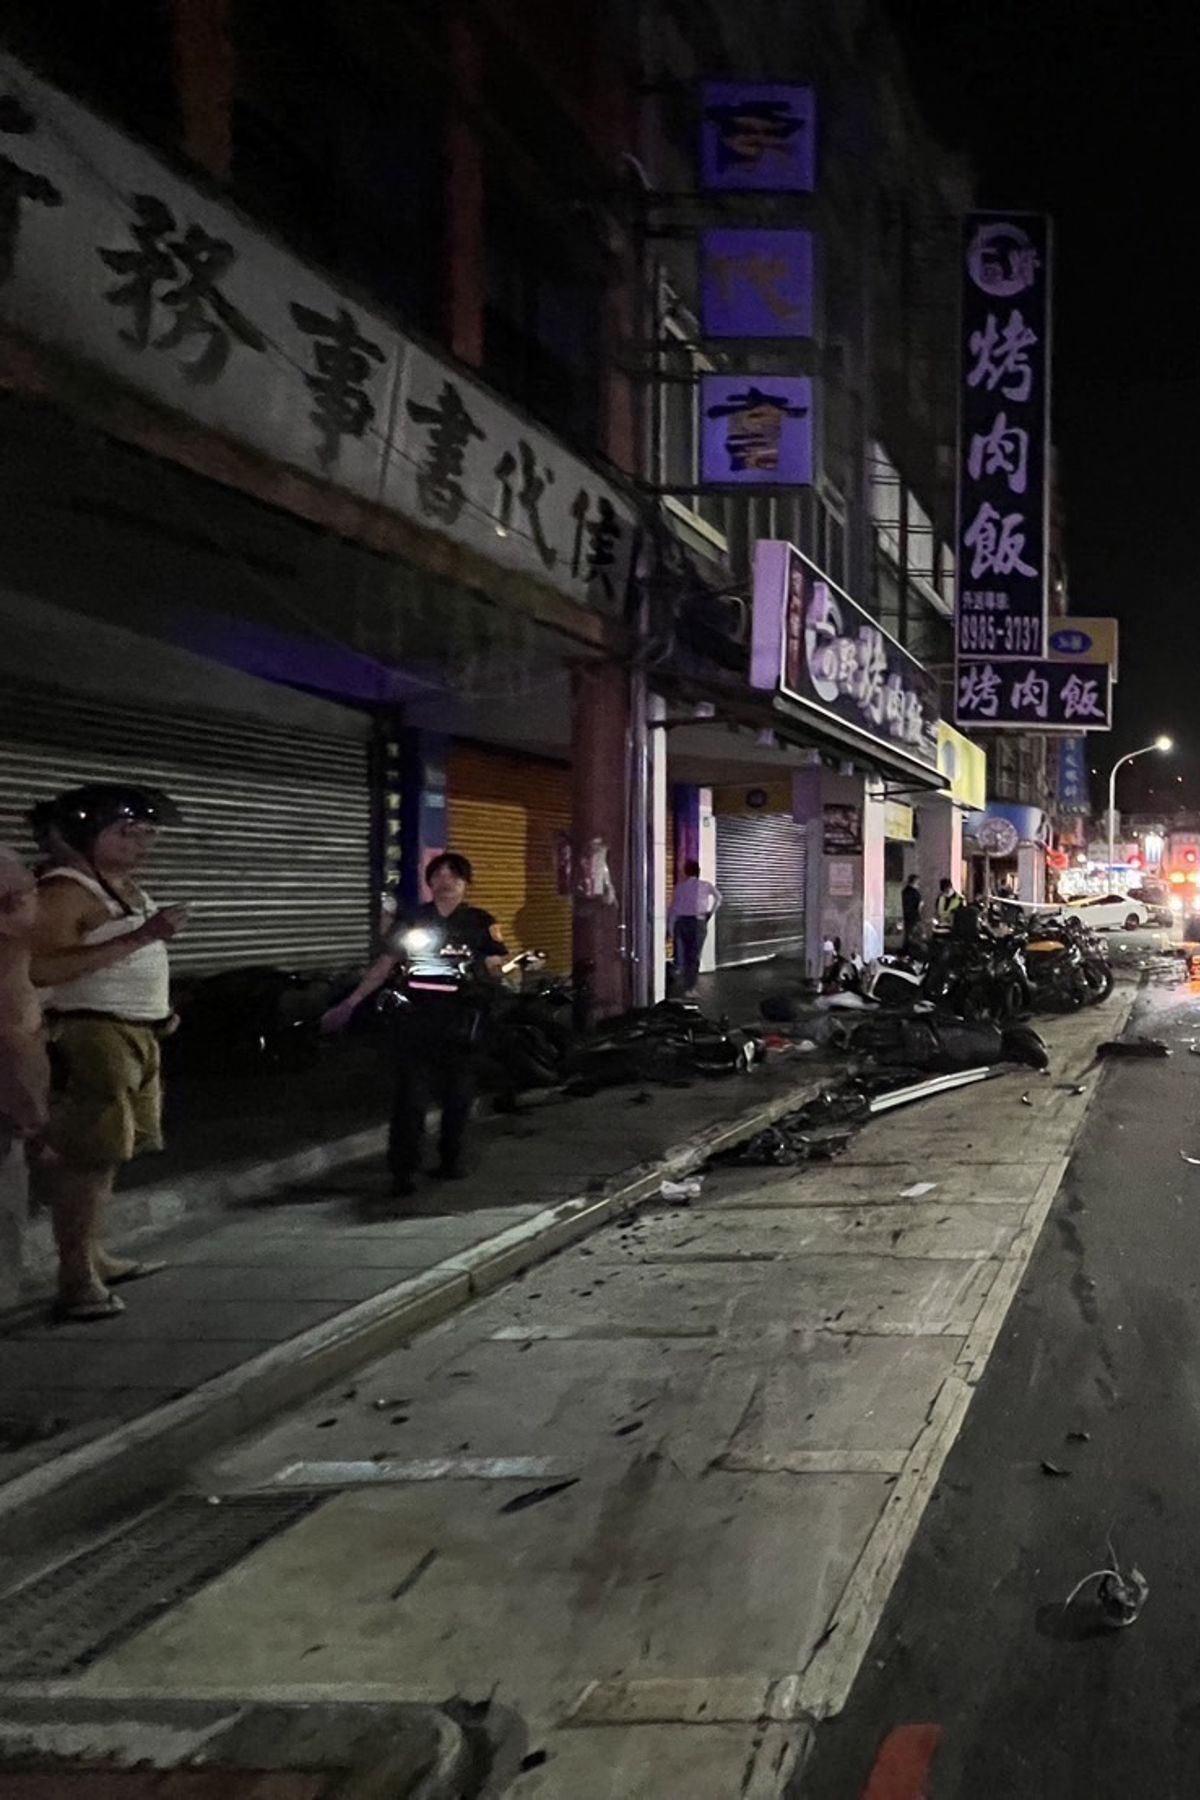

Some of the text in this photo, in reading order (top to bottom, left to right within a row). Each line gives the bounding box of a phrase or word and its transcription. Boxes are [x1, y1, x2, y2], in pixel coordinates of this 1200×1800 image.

[967, 309, 1039, 581] 烤肉飯
[958, 663, 1106, 719] 烤肉飯
